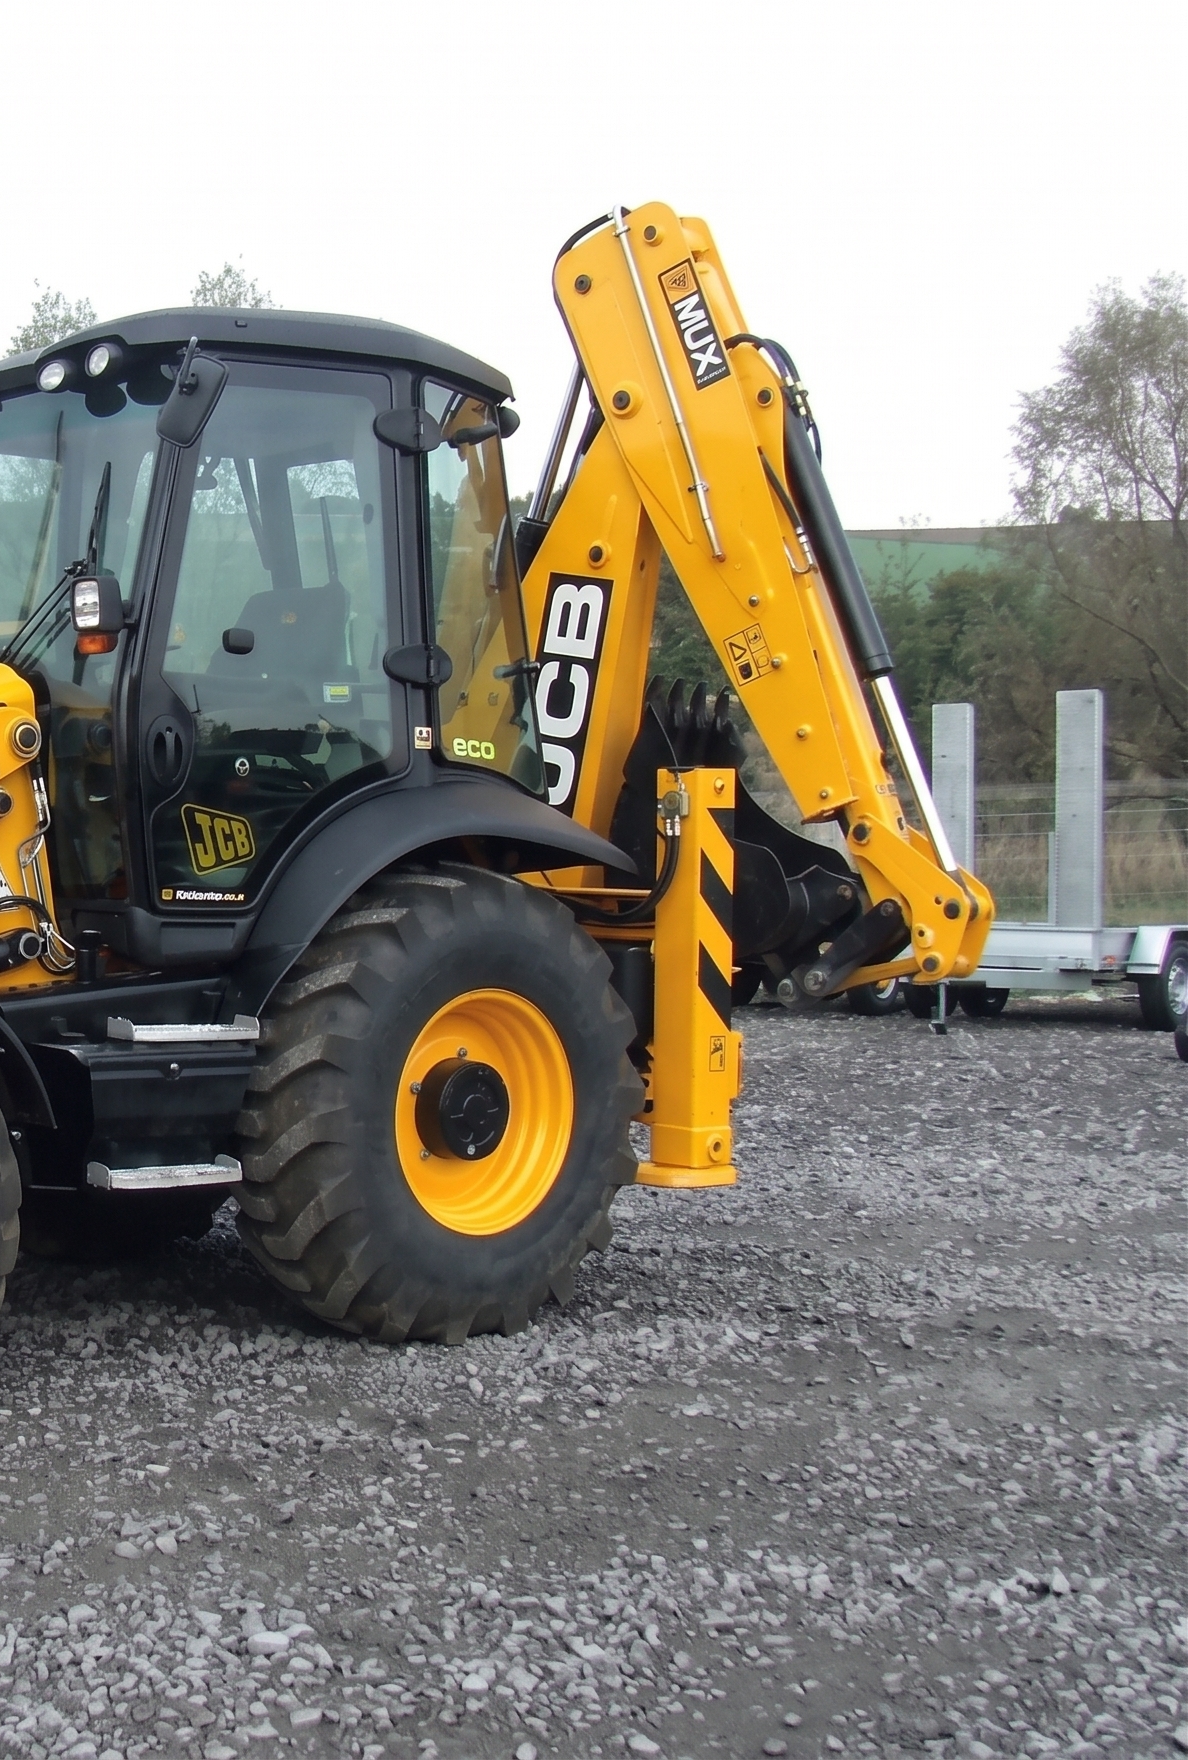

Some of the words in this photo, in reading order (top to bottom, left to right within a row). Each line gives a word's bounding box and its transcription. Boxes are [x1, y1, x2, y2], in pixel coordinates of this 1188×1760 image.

[535, 584, 604, 805] JCB
[453, 738, 495, 760] eco
[195, 811, 250, 868] JCB
